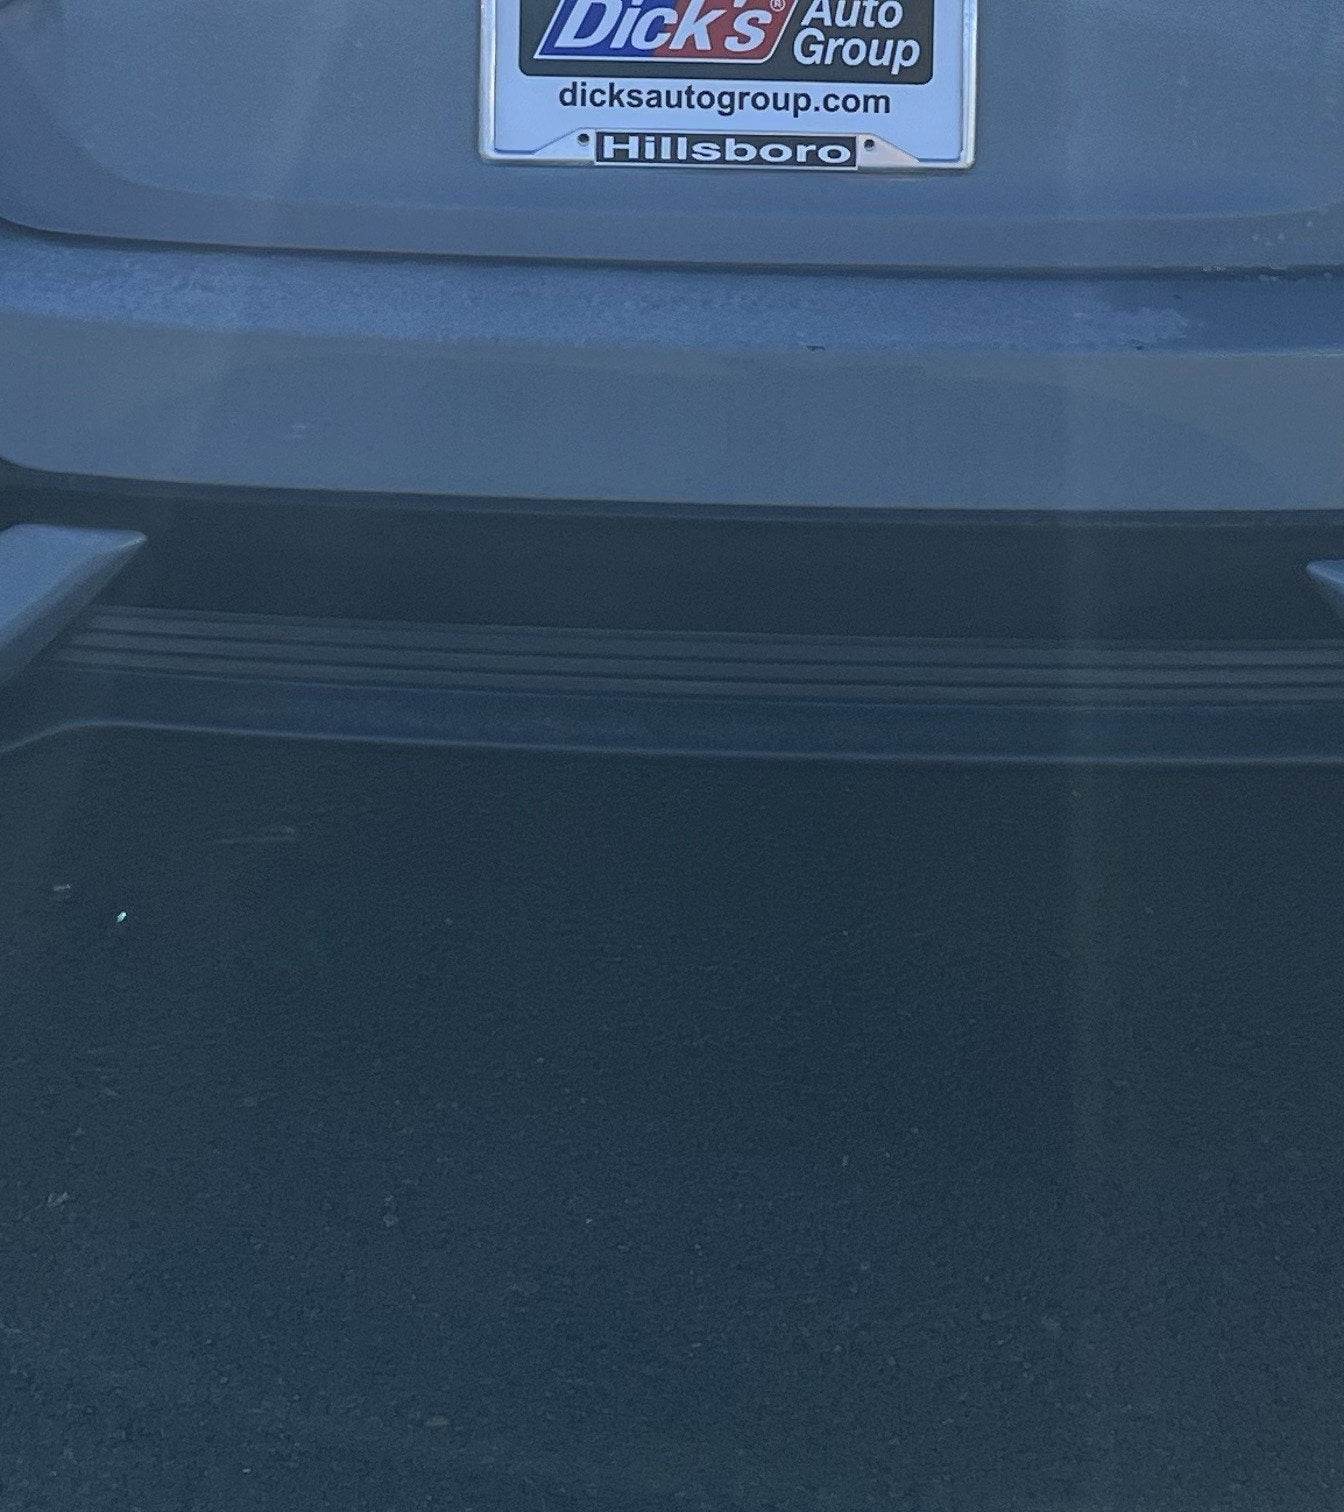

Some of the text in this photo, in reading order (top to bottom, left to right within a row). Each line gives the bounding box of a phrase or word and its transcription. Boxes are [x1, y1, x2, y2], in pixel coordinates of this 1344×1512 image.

[793, 27, 921, 74] Group
[559, 81, 892, 118] dicksautogroup.com
[603, 133, 852, 165] Hillsboro
